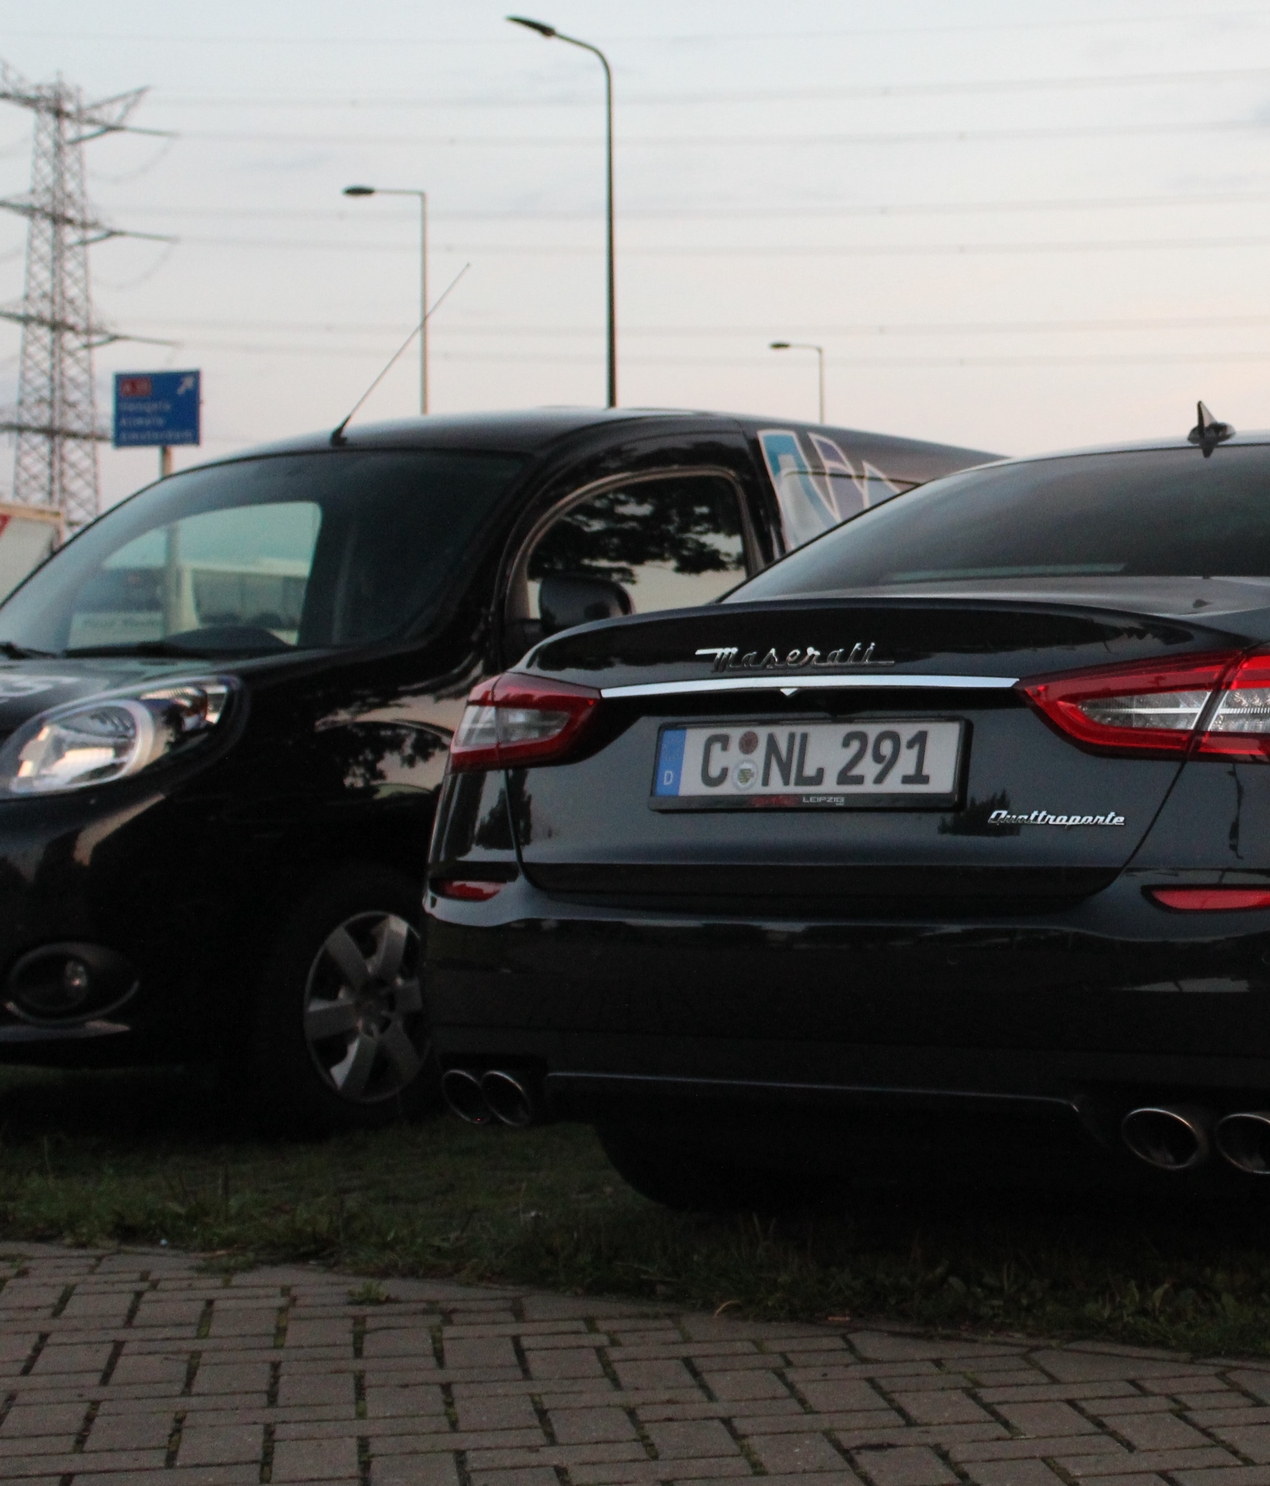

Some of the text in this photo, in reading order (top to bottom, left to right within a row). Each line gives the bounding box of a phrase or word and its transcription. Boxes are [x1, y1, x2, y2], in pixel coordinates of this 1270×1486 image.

[695, 642, 894, 673] Maserati
[700, 729, 931, 788] C NL 291
[663, 770, 674, 786] D
[988, 809, 1126, 829] Quattroporte
